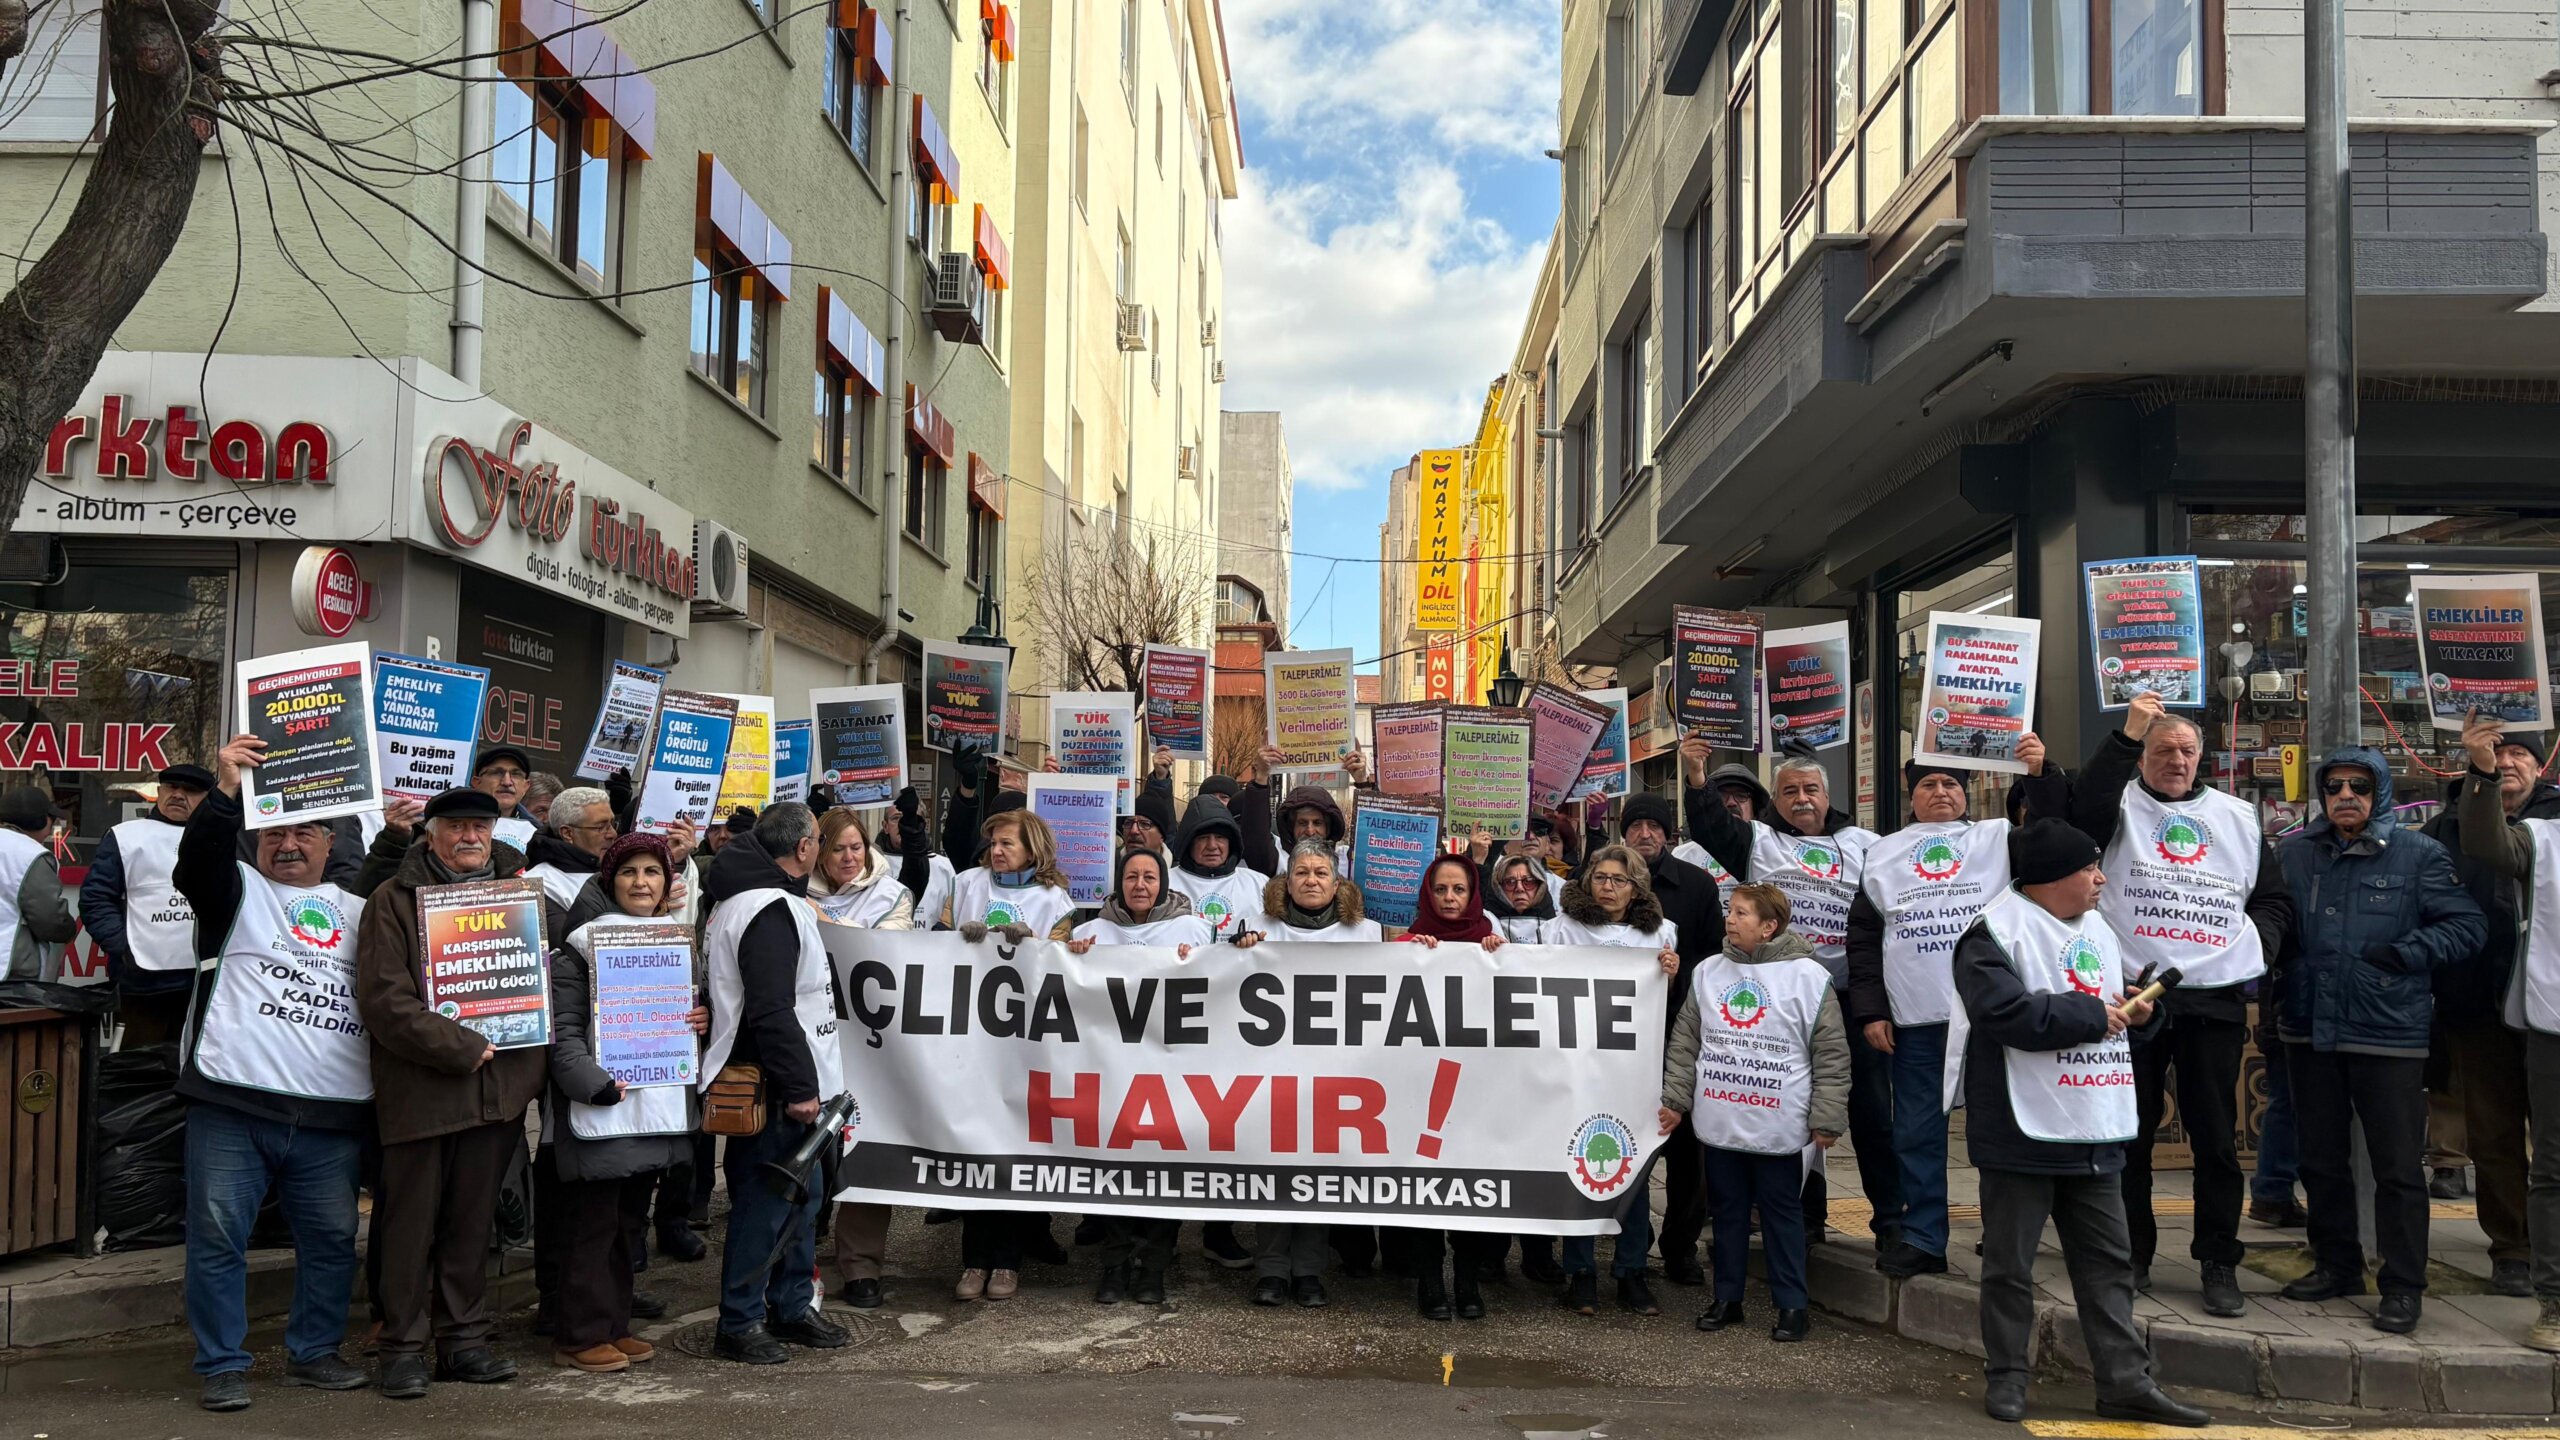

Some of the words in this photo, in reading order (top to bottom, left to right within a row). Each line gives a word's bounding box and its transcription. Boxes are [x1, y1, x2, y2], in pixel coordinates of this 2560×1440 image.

[44, 393, 336, 487] rktan
[57, 498, 145, 522] albüm
[179, 503, 297, 530] çerçeve
[1431, 478, 1449, 578] MAXIMUM
[582, 496, 695, 602] türktan
[327, 571, 353, 594] ACELE
[527, 552, 559, 582] digital
[568, 566, 607, 600] fotoğraf
[614, 588, 639, 612] albüm
[644, 600, 675, 626] çerçeve
[1422, 582, 1455, 600] DİL
[323, 593, 354, 617] VESİKALIK
[1421, 602, 1456, 611] İNGİLİZCE
[1420, 615, 1457, 623] ALMANCA
[2426, 605, 2524, 624] EMEKLİLER
[1684, 630, 1741, 643] GEÇİNEMİYORUZ!
[2100, 623, 2195, 640] EMEKLİLER
[2429, 629, 2526, 643] SALTANATINIZI
[1695, 644, 1732, 654] AYLIKLARA
[1947, 636, 1963, 646] BU
[1964, 639, 2019, 652] SALTANAT
[1945, 650, 2018, 665] RAKAMLARLA
[2438, 646, 2514, 662] YIKACAK!
[1690, 664, 1720, 674] SEYYANEN
[1721, 667, 1736, 675] ZAM
[1787, 655, 1822, 672] TÜİK
[1958, 663, 2004, 676] AYAKTA,
[0, 659, 79, 697] ELE
[258, 666, 343, 691] GEÇİNEMİYORUZ!
[1281, 665, 1342, 680] TALEPLERİMİZ
[1697, 673, 1727, 685] ŞART!
[1780, 672, 1835, 689] İKTİDARIN
[277, 682, 333, 700] AYLIKLARA
[386, 675, 443, 695] EMEKLİYE
[1936, 674, 2022, 694] EMEKLİYLE
[384, 687, 419, 704] AÇLIK,
[946, 692, 980, 707] TÜİK
[1311, 689, 1347, 699] Gösterge
[1690, 688, 1733, 700] ÖRGÜTLEN
[1771, 688, 1811, 703] NOTERİ
[1812, 683, 1844, 699] OLMA!
[1947, 694, 2009, 707] YIKILACAK!
[271, 710, 319, 725] SEYYANEN
[320, 705, 341, 718] ZAM
[382, 700, 435, 720] YANDAŞA
[1074, 711, 1110, 725] TÜİK
[285, 717, 330, 737] ŞART!
[379, 713, 439, 733] SALTANAT!
[669, 720, 693, 735] ÇARE
[821, 714, 894, 730] SALTANAT
[1280, 717, 1347, 733] Verilmelidir!
[1536, 704, 1594, 735] TALEPLERİMİZ
[1063, 729, 1079, 737] BU
[1081, 727, 1122, 738] YAĞMA
[1384, 721, 1439, 736] TALEPLERİMİZ
[665, 734, 709, 752] ÖRGÜTLÜ
[1061, 741, 1124, 750] DÜZENİNİN
[1455, 730, 1520, 745] TALEPLERİMİZ
[0, 722, 176, 772] KALIK
[264, 747, 297, 760] Enflasyon
[297, 740, 334, 754] yalanlarına
[390, 741, 408, 755] Bu
[410, 745, 456, 760] yağma
[662, 751, 713, 769] MÜCADELE!
[1062, 752, 1122, 762] İSTATİSTİK
[1281, 751, 1330, 764] ÖRGÜTLEN
[1384, 750, 1412, 763] İntibak
[1452, 751, 1480, 763] Bayram
[1483, 750, 1522, 763] İkramiyesi
[409, 760, 454, 776] düzeni
[1060, 765, 1125, 774] DAİRESİDİR!
[1452, 768, 1471, 777] Yılda
[1473, 768, 1478, 777] 4
[1480, 768, 1496, 778] Kez
[1497, 769, 1521, 779] olmalı
[265, 776, 289, 787] Sadaka
[674, 777, 711, 793] Örgütlen
[285, 791, 304, 802] TÜM
[306, 783, 365, 799] EMEKLİLERİN
[688, 795, 709, 806] diren
[1042, 793, 1104, 808] TALEPLERİMİZ
[302, 796, 350, 809] SENDİKASI
[1452, 796, 1520, 810] Yükseltilmelidir!
[1365, 816, 1429, 833] TALEPLERİMİZ
[1368, 834, 1422, 851] Emeklilerin
[2130, 868, 2192, 883] ESKİŞEHİR
[2195, 875, 2236, 892] ŞUBESİ
[2132, 860, 2148, 868] TÜM
[2150, 863, 2197, 875] EMEKLİLERİN
[2198, 871, 2235, 884] SENDİKASI
[1774, 881, 1827, 893] ESKİŞEHİR
[1897, 890, 1945, 905] ESKİŞEHİR
[1948, 886, 1982, 897] ŞUBESİ
[2124, 884, 2179, 901] İNSANCA
[2183, 893, 2236, 912] YAŞAMAK
[454, 909, 507, 933] TÜİK
[2134, 904, 2229, 928] HAKKIMIZ!
[2133, 924, 2228, 948] ALACAĞIZ!
[443, 936, 527, 956] KARŞISINDA,
[435, 949, 537, 977] EMEKLİNİN
[606, 953, 682, 970] TALEPLERİMİZ
[436, 977, 498, 996] ÖRGÜTLÜ
[500, 974, 539, 989] GÜCÜ!
[281, 987, 351, 1016] KADER
[258, 1002, 365, 1038] DEĞİLDİR!
[602, 1011, 634, 1025] 56.000
[1106, 977, 1209, 1045] VE
[1238, 972, 1637, 1051] SEFALETE
[1705, 1035, 1749, 1049] ESKİŞEHİR
[1752, 1041, 1790, 1054] ŞUBESİ
[1756, 1033, 1790, 1044] SENDİKASI
[605, 1053, 618, 1061] TÜM
[618, 1051, 651, 1060] EMEKLİLERİN
[652, 1050, 690, 1059] SENDİKASINDA
[606, 1066, 669, 1083] ÖRGÜTLEN
[1740, 1058, 1793, 1074] YAŞAMAK
[1703, 1069, 1782, 1090] HAKKIMIZ!
[1703, 1087, 1781, 1109] ALACAĞIZ!
[1027, 1070, 1390, 1155] HAYIR
[1567, 1139, 1576, 1156] TÜM
[1574, 1113, 1613, 1138] EMEKLİLERİN
[1616, 1118, 1638, 1156] SENDİKASI
[911, 1156, 996, 1190] TÜM
[1010, 1163, 1276, 1202] EMEKLİLERİN
[1290, 1174, 1511, 1209] SENDİKASI
